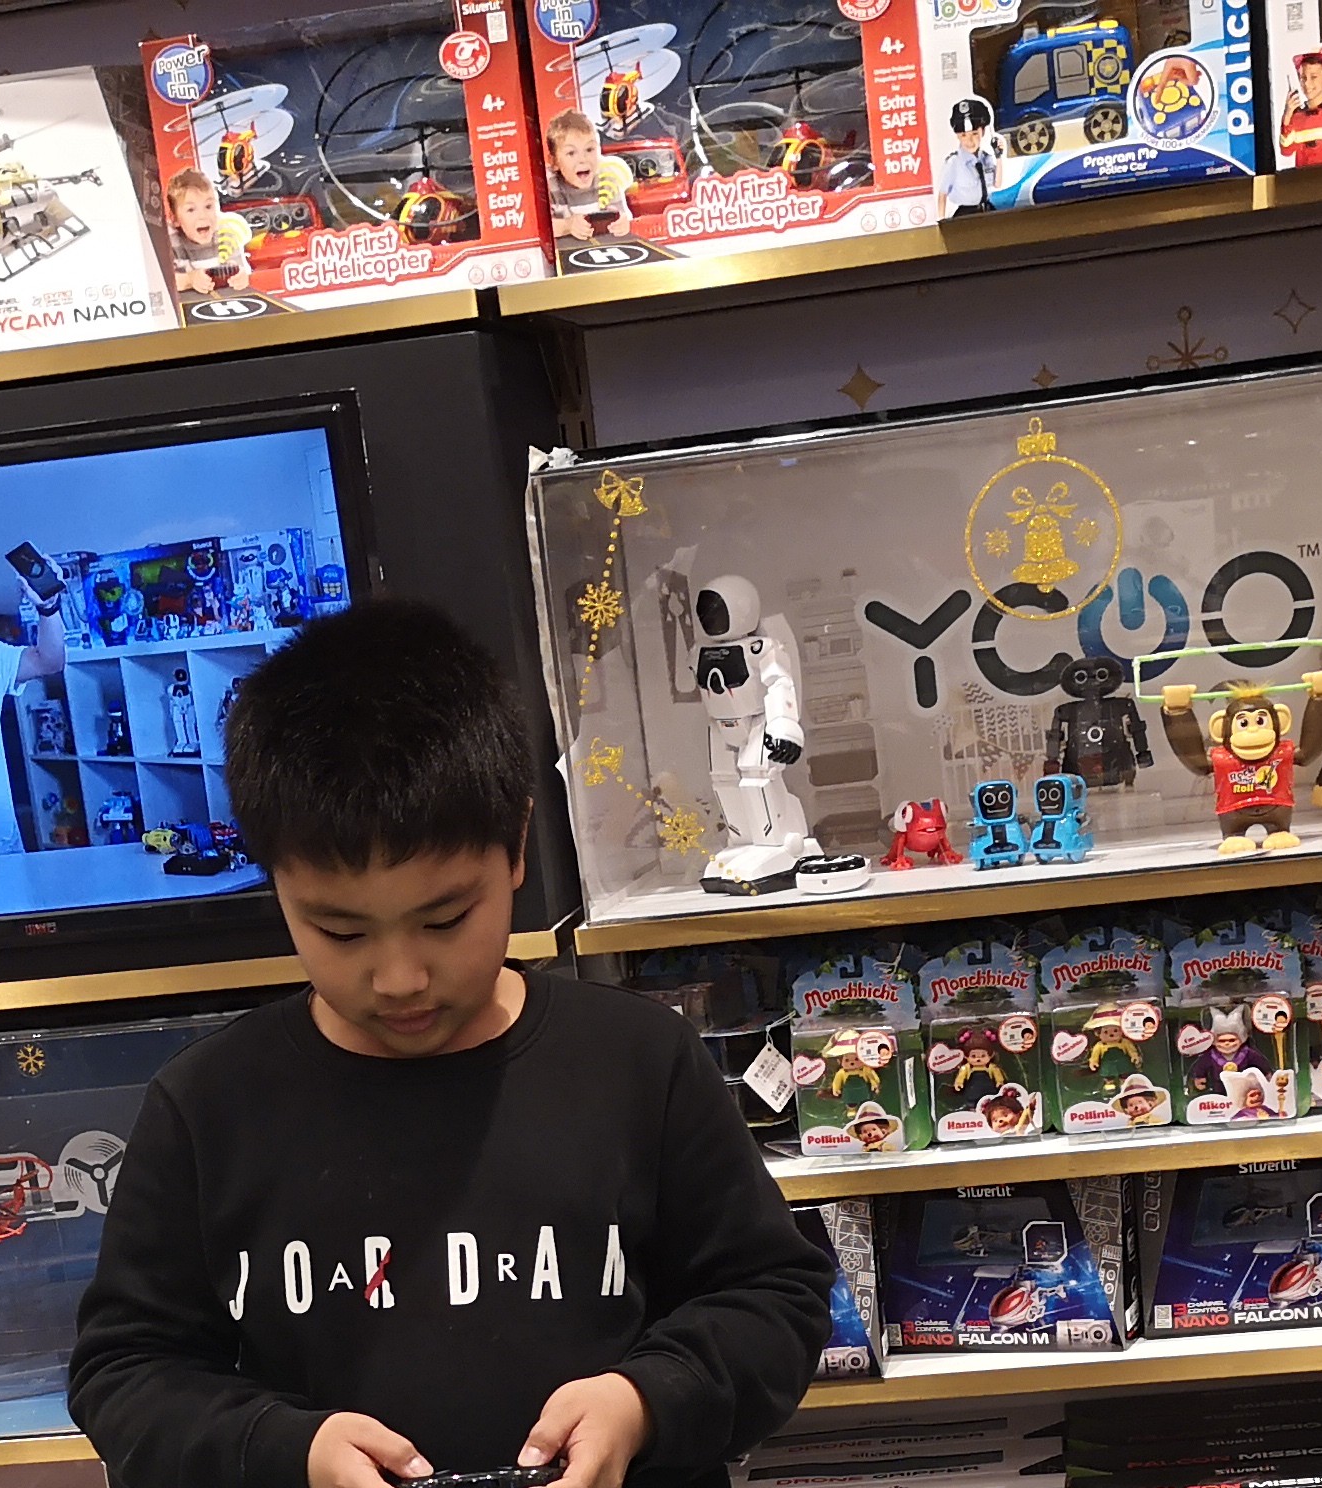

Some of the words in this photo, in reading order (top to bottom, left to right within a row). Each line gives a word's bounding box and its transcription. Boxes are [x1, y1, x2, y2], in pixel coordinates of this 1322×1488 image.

[557, 8, 571, 21] in
[551, 20, 584, 37] Fun
[880, 38, 905, 54] 4+
[157, 46, 209, 74] Power
[171, 68, 188, 85] in
[166, 82, 199, 99] Fun
[482, 94, 505, 112] 4+
[878, 95, 916, 112] Extra
[881, 112, 917, 128] SAFE
[1161, 138, 1184, 150] 100+
[1185, 109, 1219, 145] COMMANDS
[883, 136, 920, 156] Easy
[483, 149, 518, 167] Extra
[1082, 151, 1136, 170] Program
[1137, 147, 1159, 161] Me
[485, 167, 520, 184] SAFE
[1098, 165, 1129, 177] Police
[1129, 161, 1149, 172] Car
[696, 182, 733, 210] My
[734, 175, 787, 201] First
[488, 192, 523, 213] Easy
[670, 211, 703, 235] RC
[705, 198, 822, 231] Helicopter
[314, 234, 349, 260] My
[350, 228, 399, 254] First
[285, 266, 319, 289] RC
[321, 249, 431, 286] Helicopter
[72, 299, 147, 323] NANO
[1232, 783, 1254, 794] Roll
[1053, 951, 1153, 986] Monchhichi
[1182, 950, 1286, 985] Monchhichi
[931, 968, 1031, 1003] Monchhichi
[804, 983, 900, 1014] Monchhichi
[1070, 1107, 1117, 1122] Pollinia
[806, 1132, 852, 1147] Pollinia
[957, 1185, 1015, 1198] Silverlit
[1173, 1303, 1187, 1316] 3
[1173, 1314, 1230, 1329] NANO
[1233, 1306, 1310, 1325] FALCON
[902, 1320, 915, 1333] 3
[902, 1333, 955, 1346] NANO
[958, 1332, 1029, 1346] FALCON
[1031, 1332, 1050, 1345] M
[787, 1439, 873, 1453] DRONE
[880, 1432, 986, 1446] GRIPPER
[1128, 1454, 1231, 1469] FALCON
[776, 1475, 864, 1486] DRONE
[872, 1465, 980, 1480] GRIPPER
